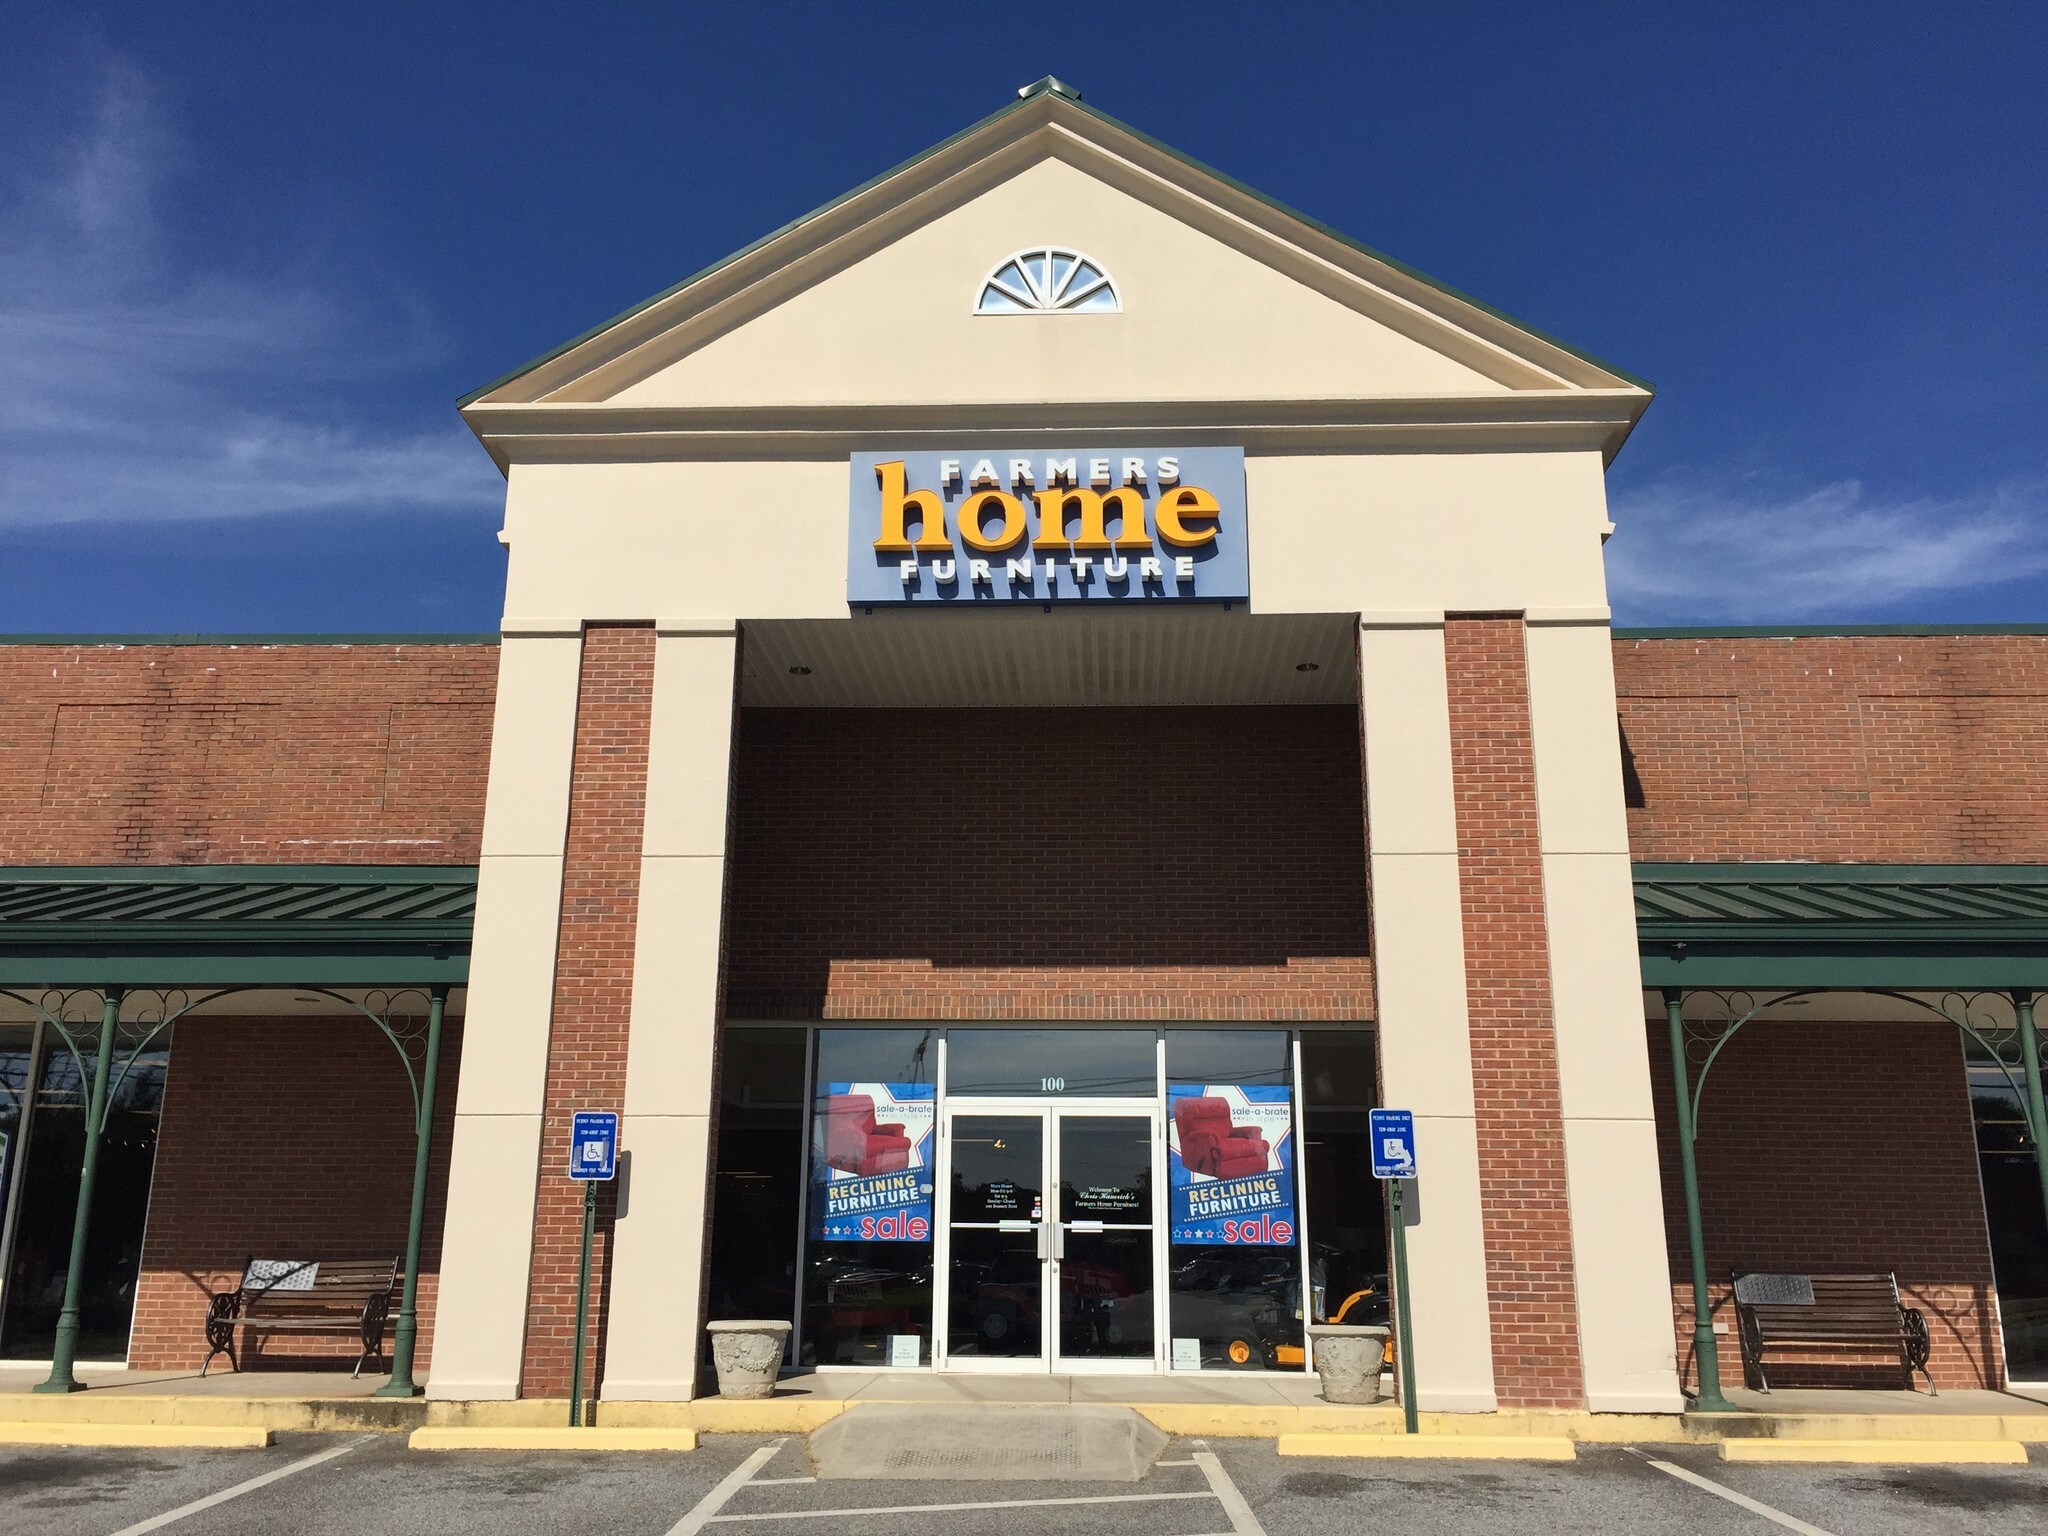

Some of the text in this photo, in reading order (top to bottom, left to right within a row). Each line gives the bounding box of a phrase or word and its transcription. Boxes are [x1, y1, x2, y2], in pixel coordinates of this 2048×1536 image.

[940, 456, 1181, 487] FARMERS
[873, 460, 1221, 552] home
[900, 556, 1196, 585] FURNITURE
[1041, 1077, 1065, 1091] 100
[876, 1104, 932, 1113] sale-a-brate
[1232, 1107, 1289, 1116] sale-a-brate
[828, 1175, 916, 1199] RECLINING
[1079, 1191, 1098, 1199] Chris
[1188, 1178, 1277, 1203] RECLINING
[828, 1187, 920, 1213] FURNITURE
[1189, 1191, 1281, 1216] FURNITURE
[860, 1210, 929, 1239] sale
[1223, 1213, 1293, 1243] sale
